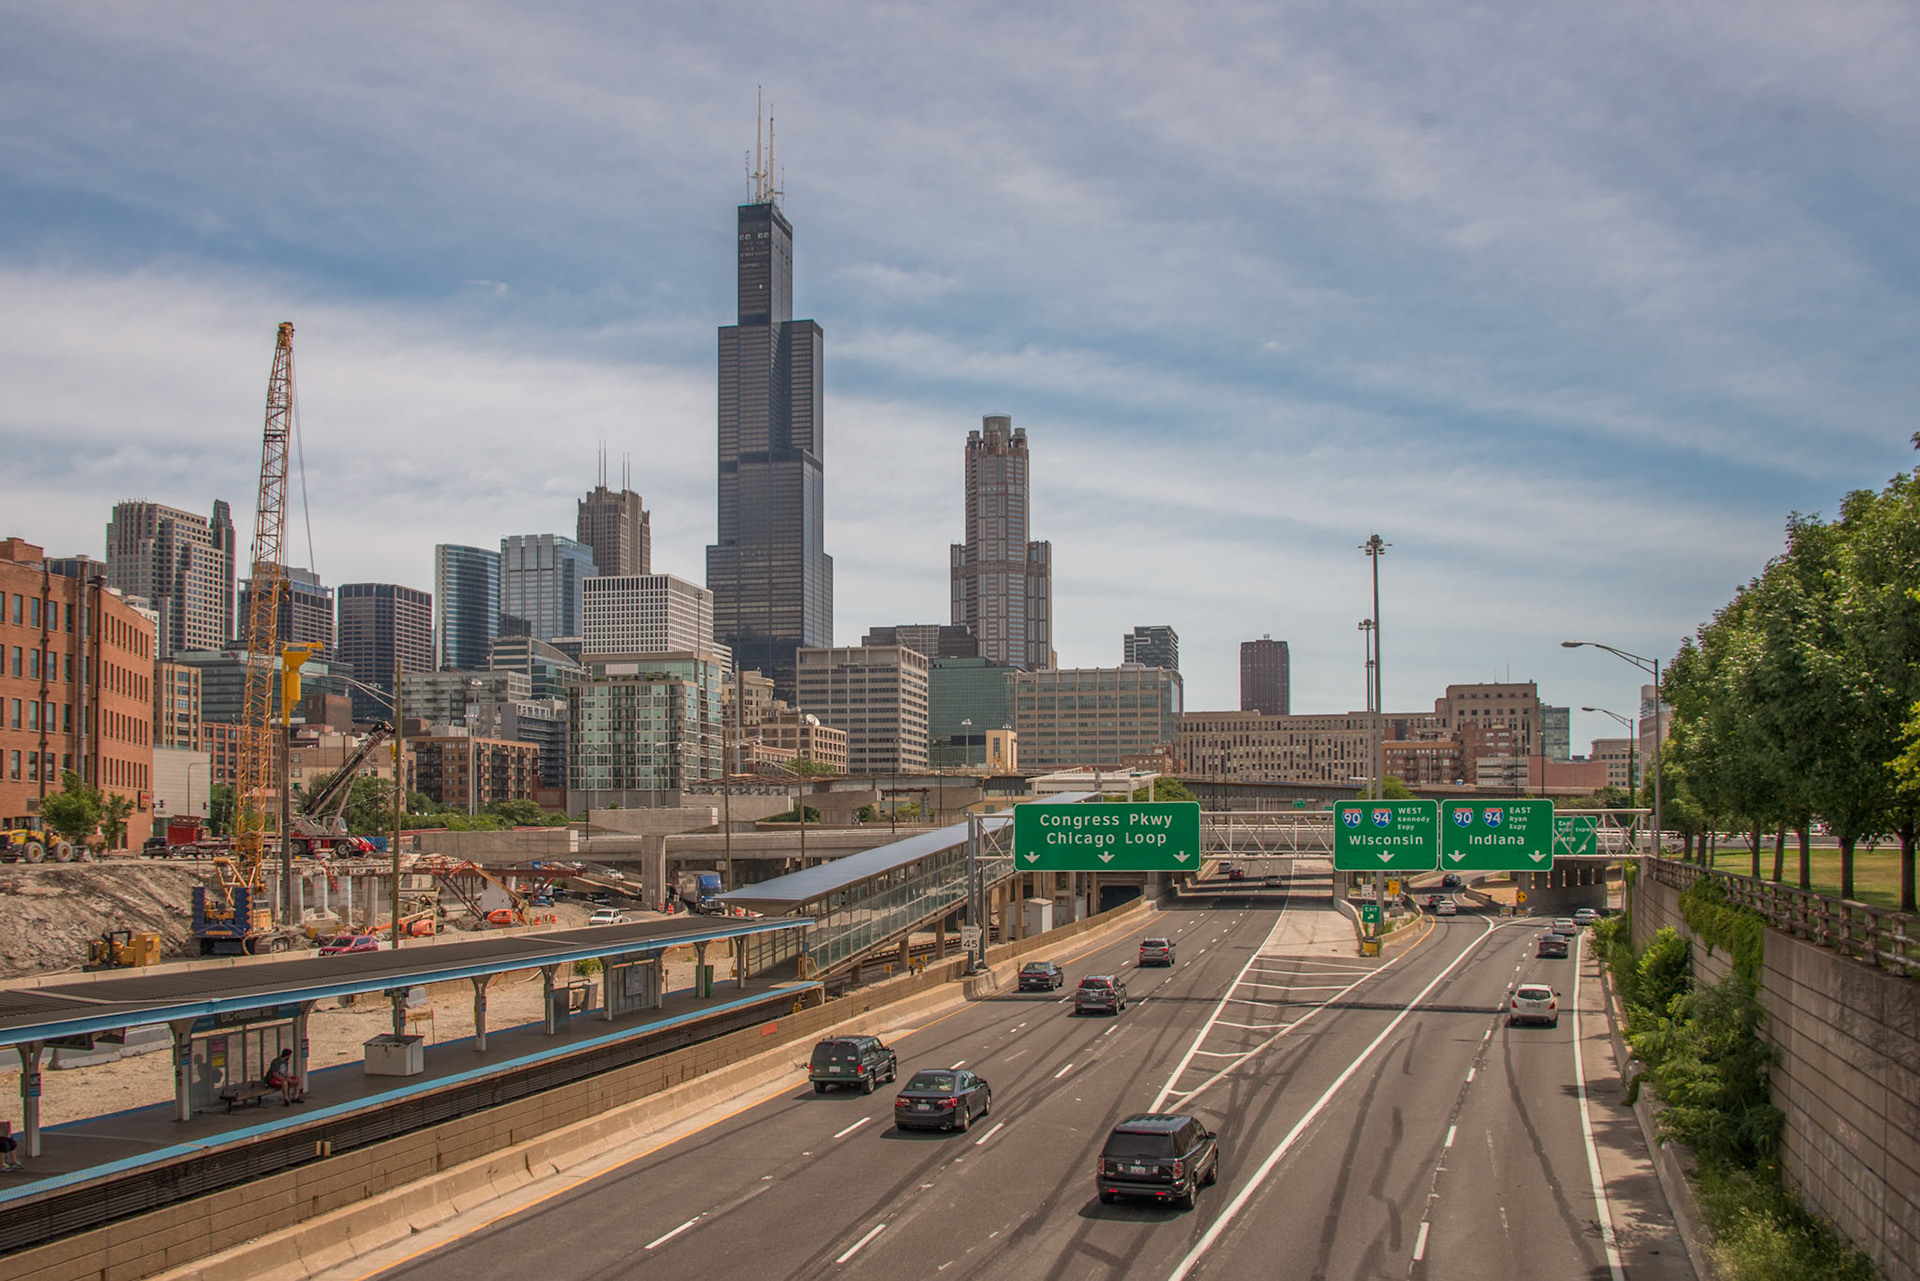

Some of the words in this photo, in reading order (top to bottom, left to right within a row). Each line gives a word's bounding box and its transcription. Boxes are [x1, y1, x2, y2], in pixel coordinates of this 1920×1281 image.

[1039, 814, 1120, 829] Congress
[1129, 813, 1173, 828] Pkwy
[1344, 813, 1361, 824] 90
[1373, 813, 1389, 823] 94
[1454, 812, 1472, 823] 90
[1484, 812, 1501, 823] 94
[1046, 832, 1116, 847] Chicago
[1125, 832, 1167, 847] Loop
[1349, 834, 1424, 845] Wisconsin
[1469, 834, 1525, 845] Indiana
[963, 940, 978, 948] 45
